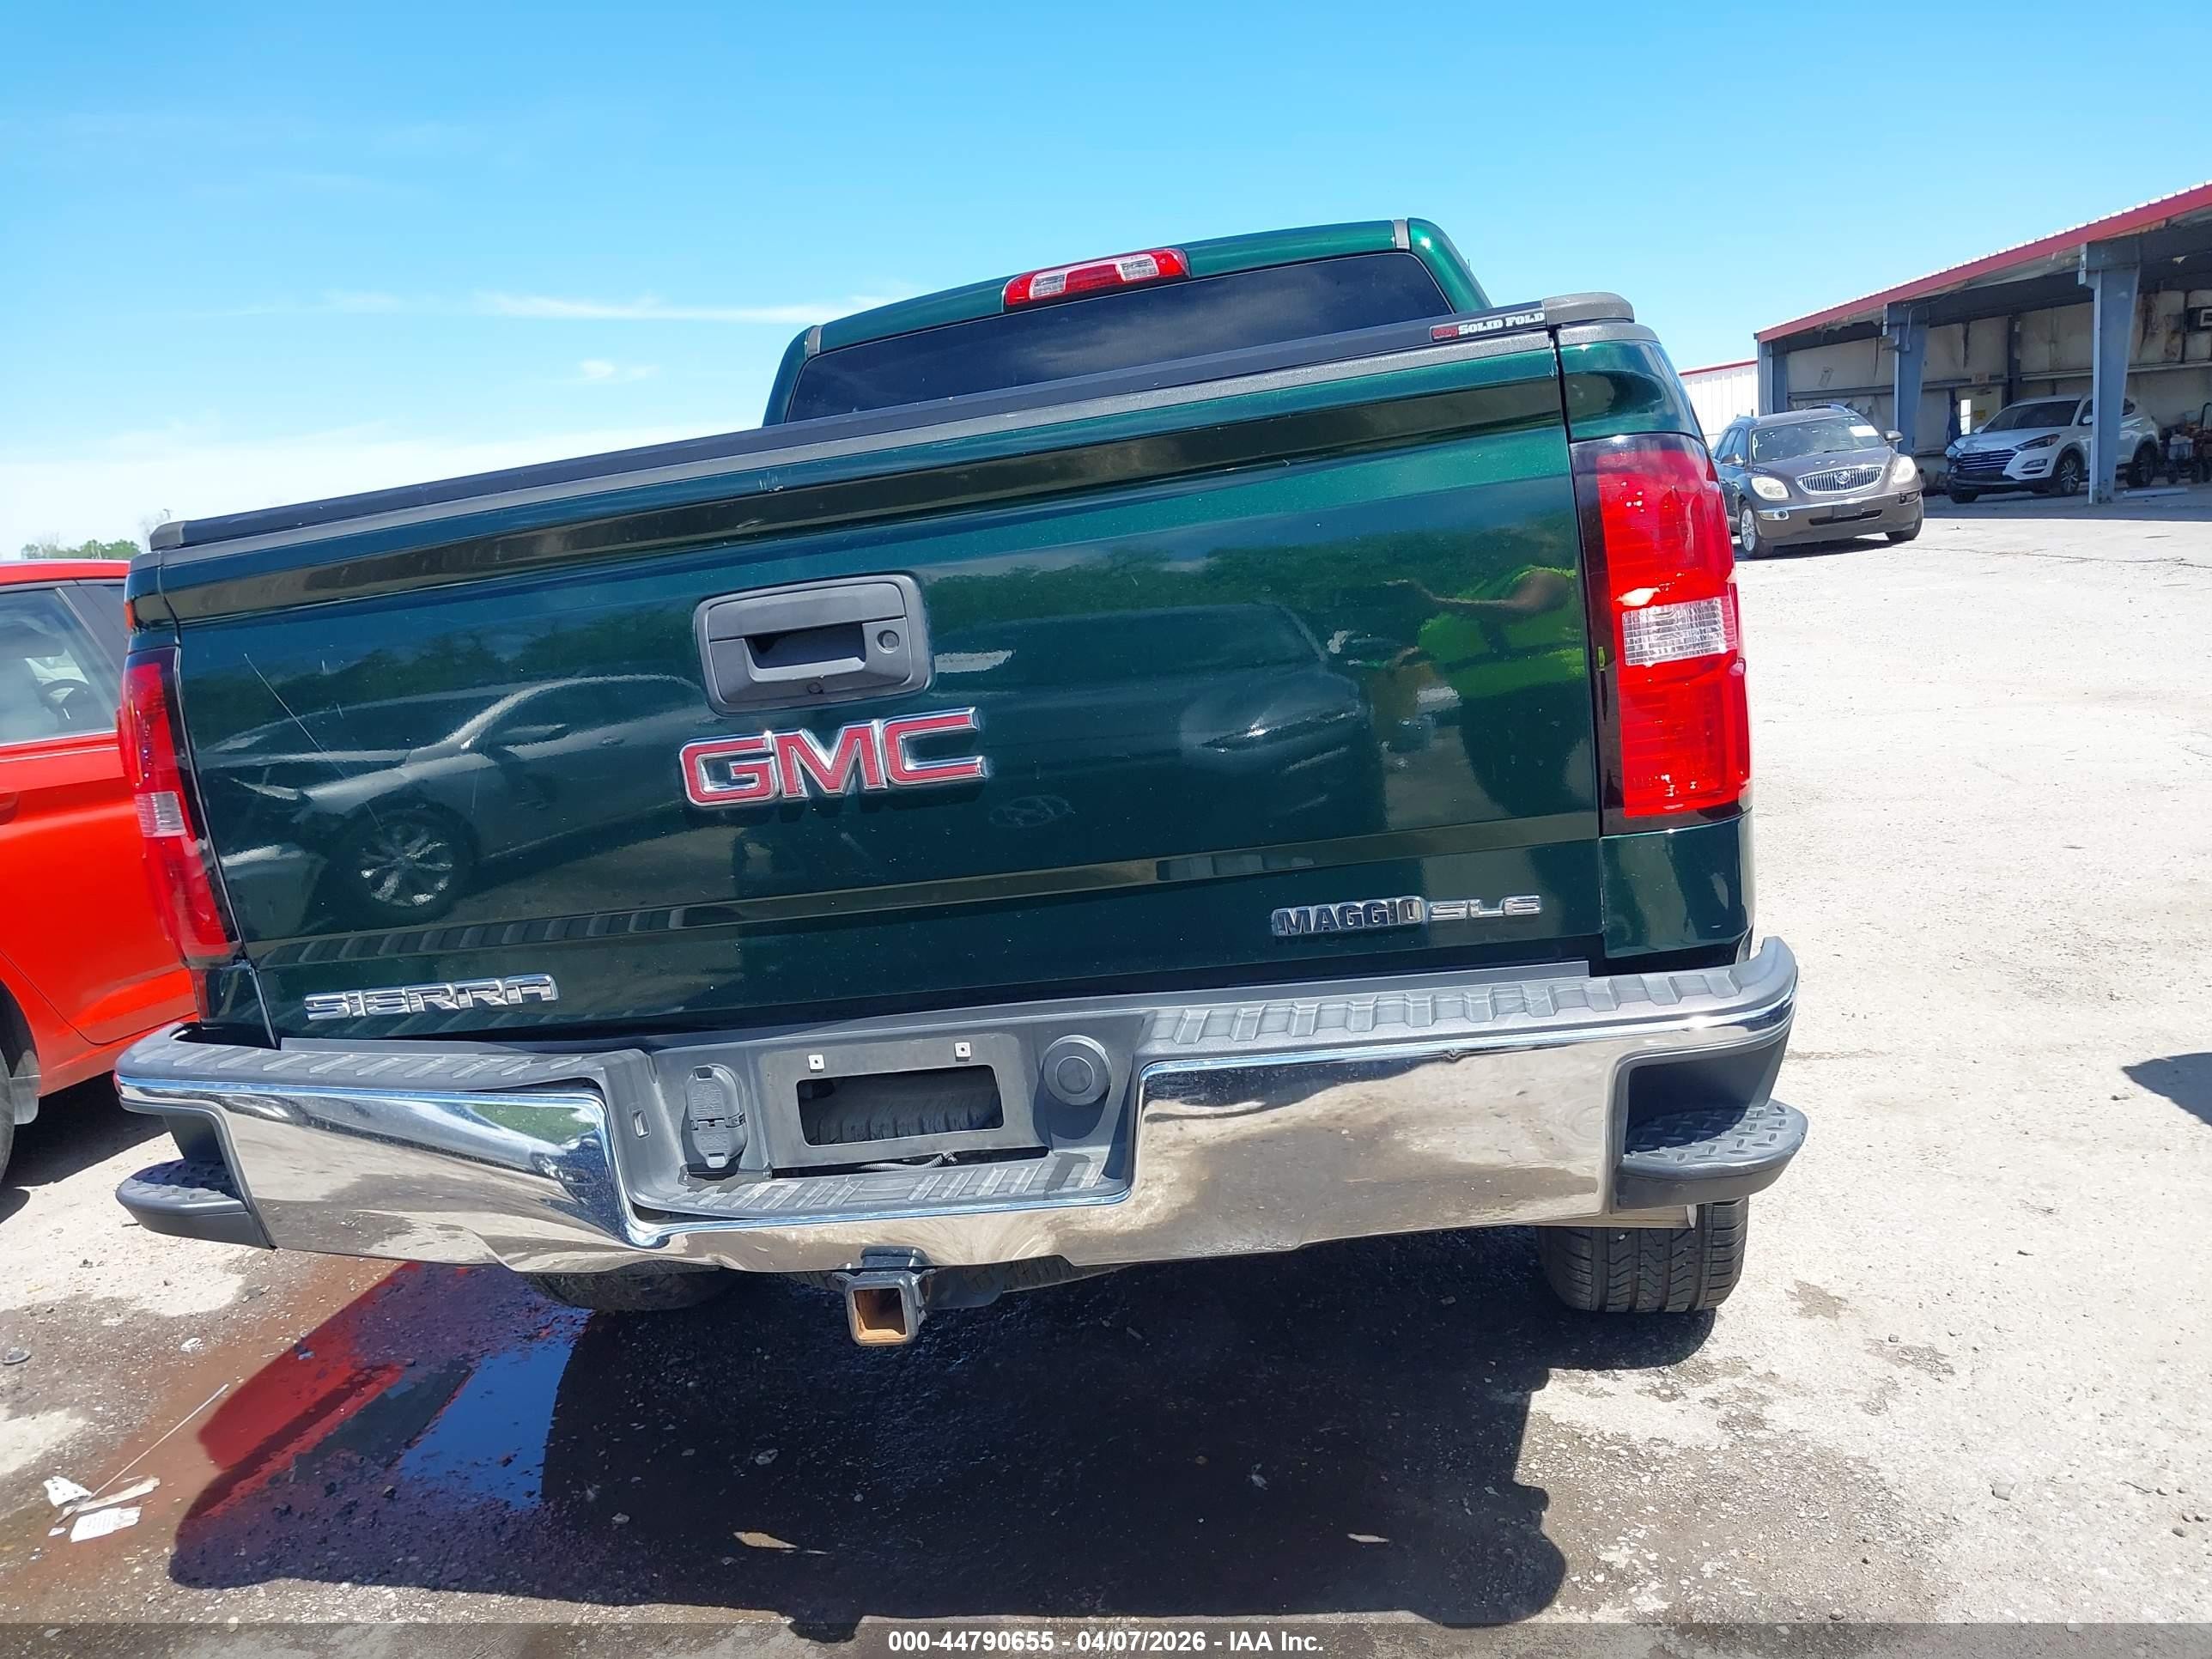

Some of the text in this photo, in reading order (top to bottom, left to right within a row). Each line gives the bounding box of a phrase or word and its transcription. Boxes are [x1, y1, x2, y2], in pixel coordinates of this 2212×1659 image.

[1458, 319, 1503, 335] SOLID
[1505, 313, 1545, 326] FOLD
[680, 707, 987, 807] GMC
[1272, 896, 1423, 936] MAGGIO
[1430, 895, 1541, 921] SLE
[304, 973, 558, 1021] SIERRA
